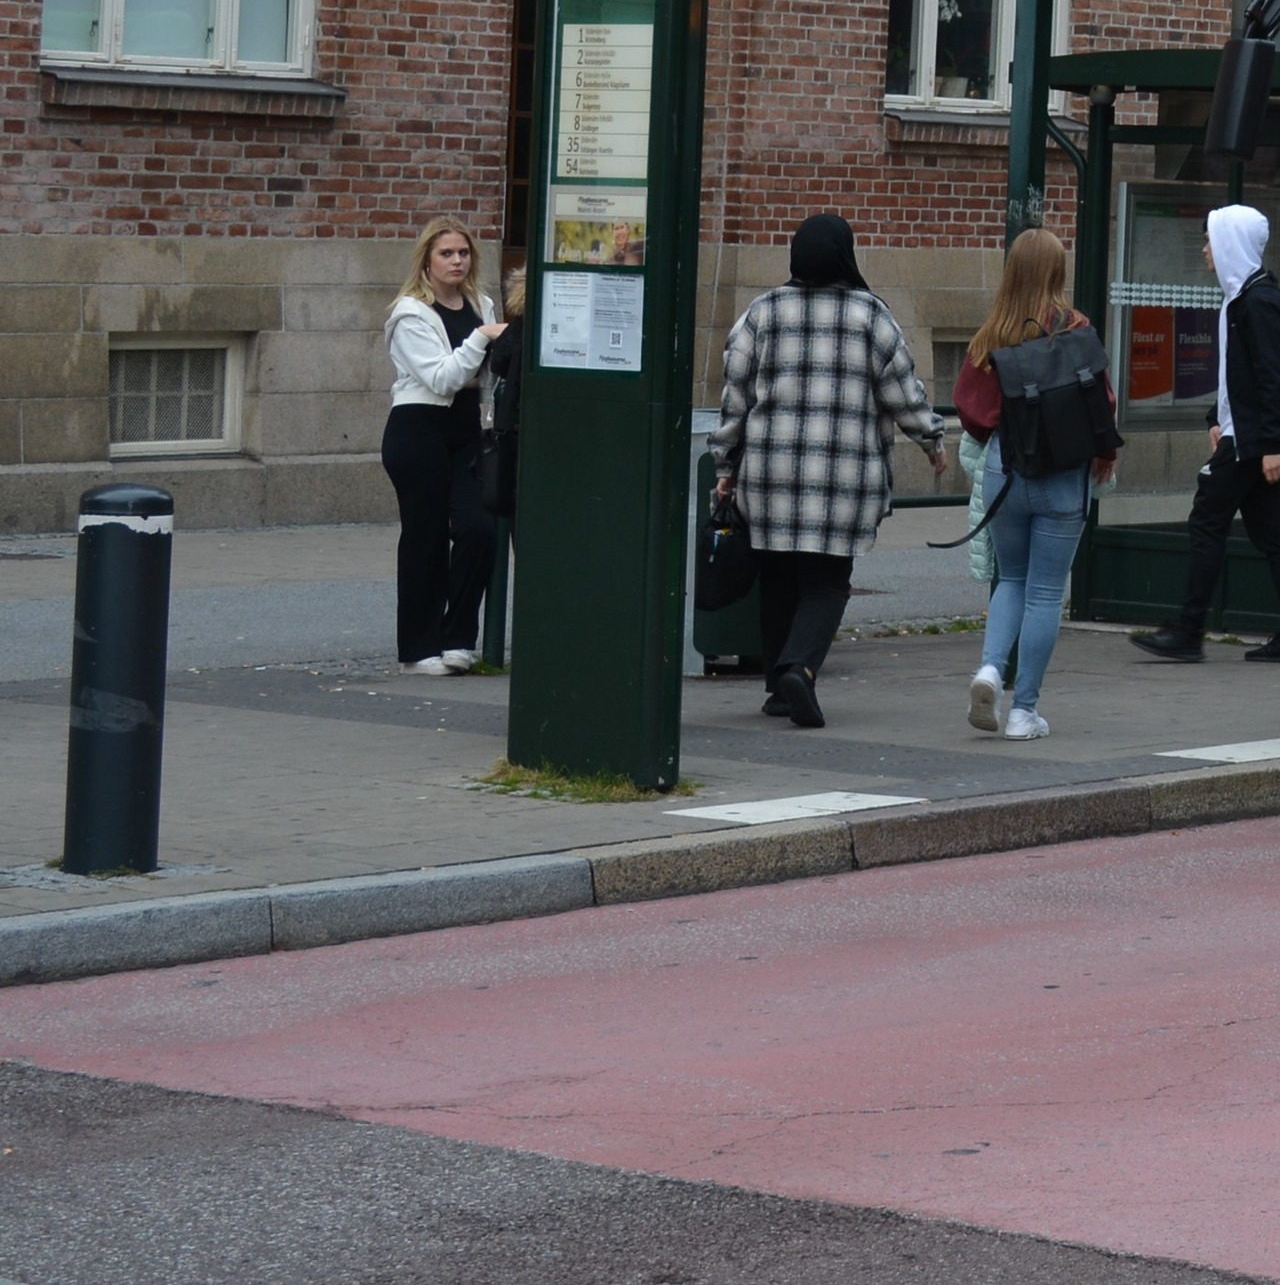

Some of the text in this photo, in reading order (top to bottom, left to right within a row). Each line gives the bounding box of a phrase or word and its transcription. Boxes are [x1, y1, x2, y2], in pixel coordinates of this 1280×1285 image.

[578, 28, 584, 43] 1
[577, 49, 584, 65] 2
[575, 71, 583, 88] 6
[575, 93, 582, 109] 7
[573, 115, 581, 131] 8
[566, 137, 580, 153] 35
[565, 158, 578, 175] 54
[1179, 332, 1212, 345] Flexibla
